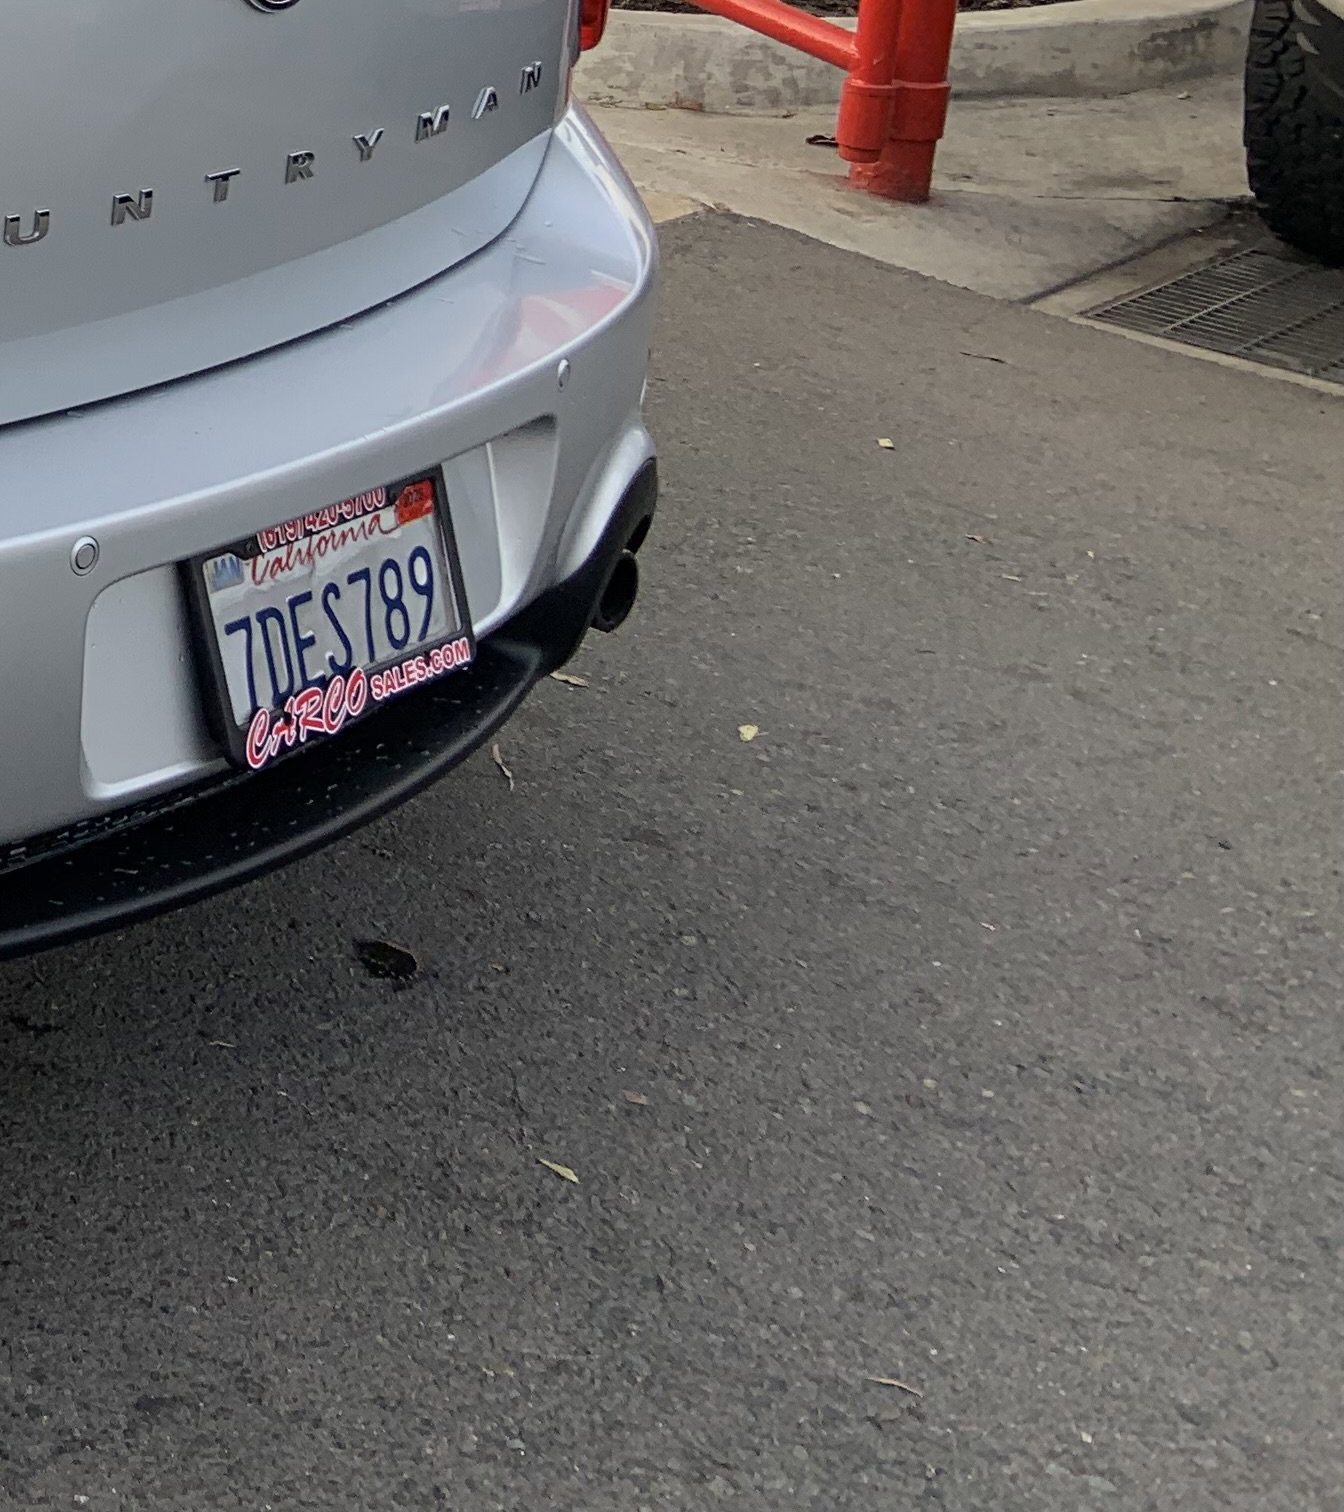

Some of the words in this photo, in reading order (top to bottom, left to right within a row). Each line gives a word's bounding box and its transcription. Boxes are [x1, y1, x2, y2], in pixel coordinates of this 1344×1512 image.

[251, 510, 400, 585] California
[224, 546, 434, 713] 7DES789
[246, 668, 367, 768] CARCO
[370, 637, 470, 700] SALES.COM
